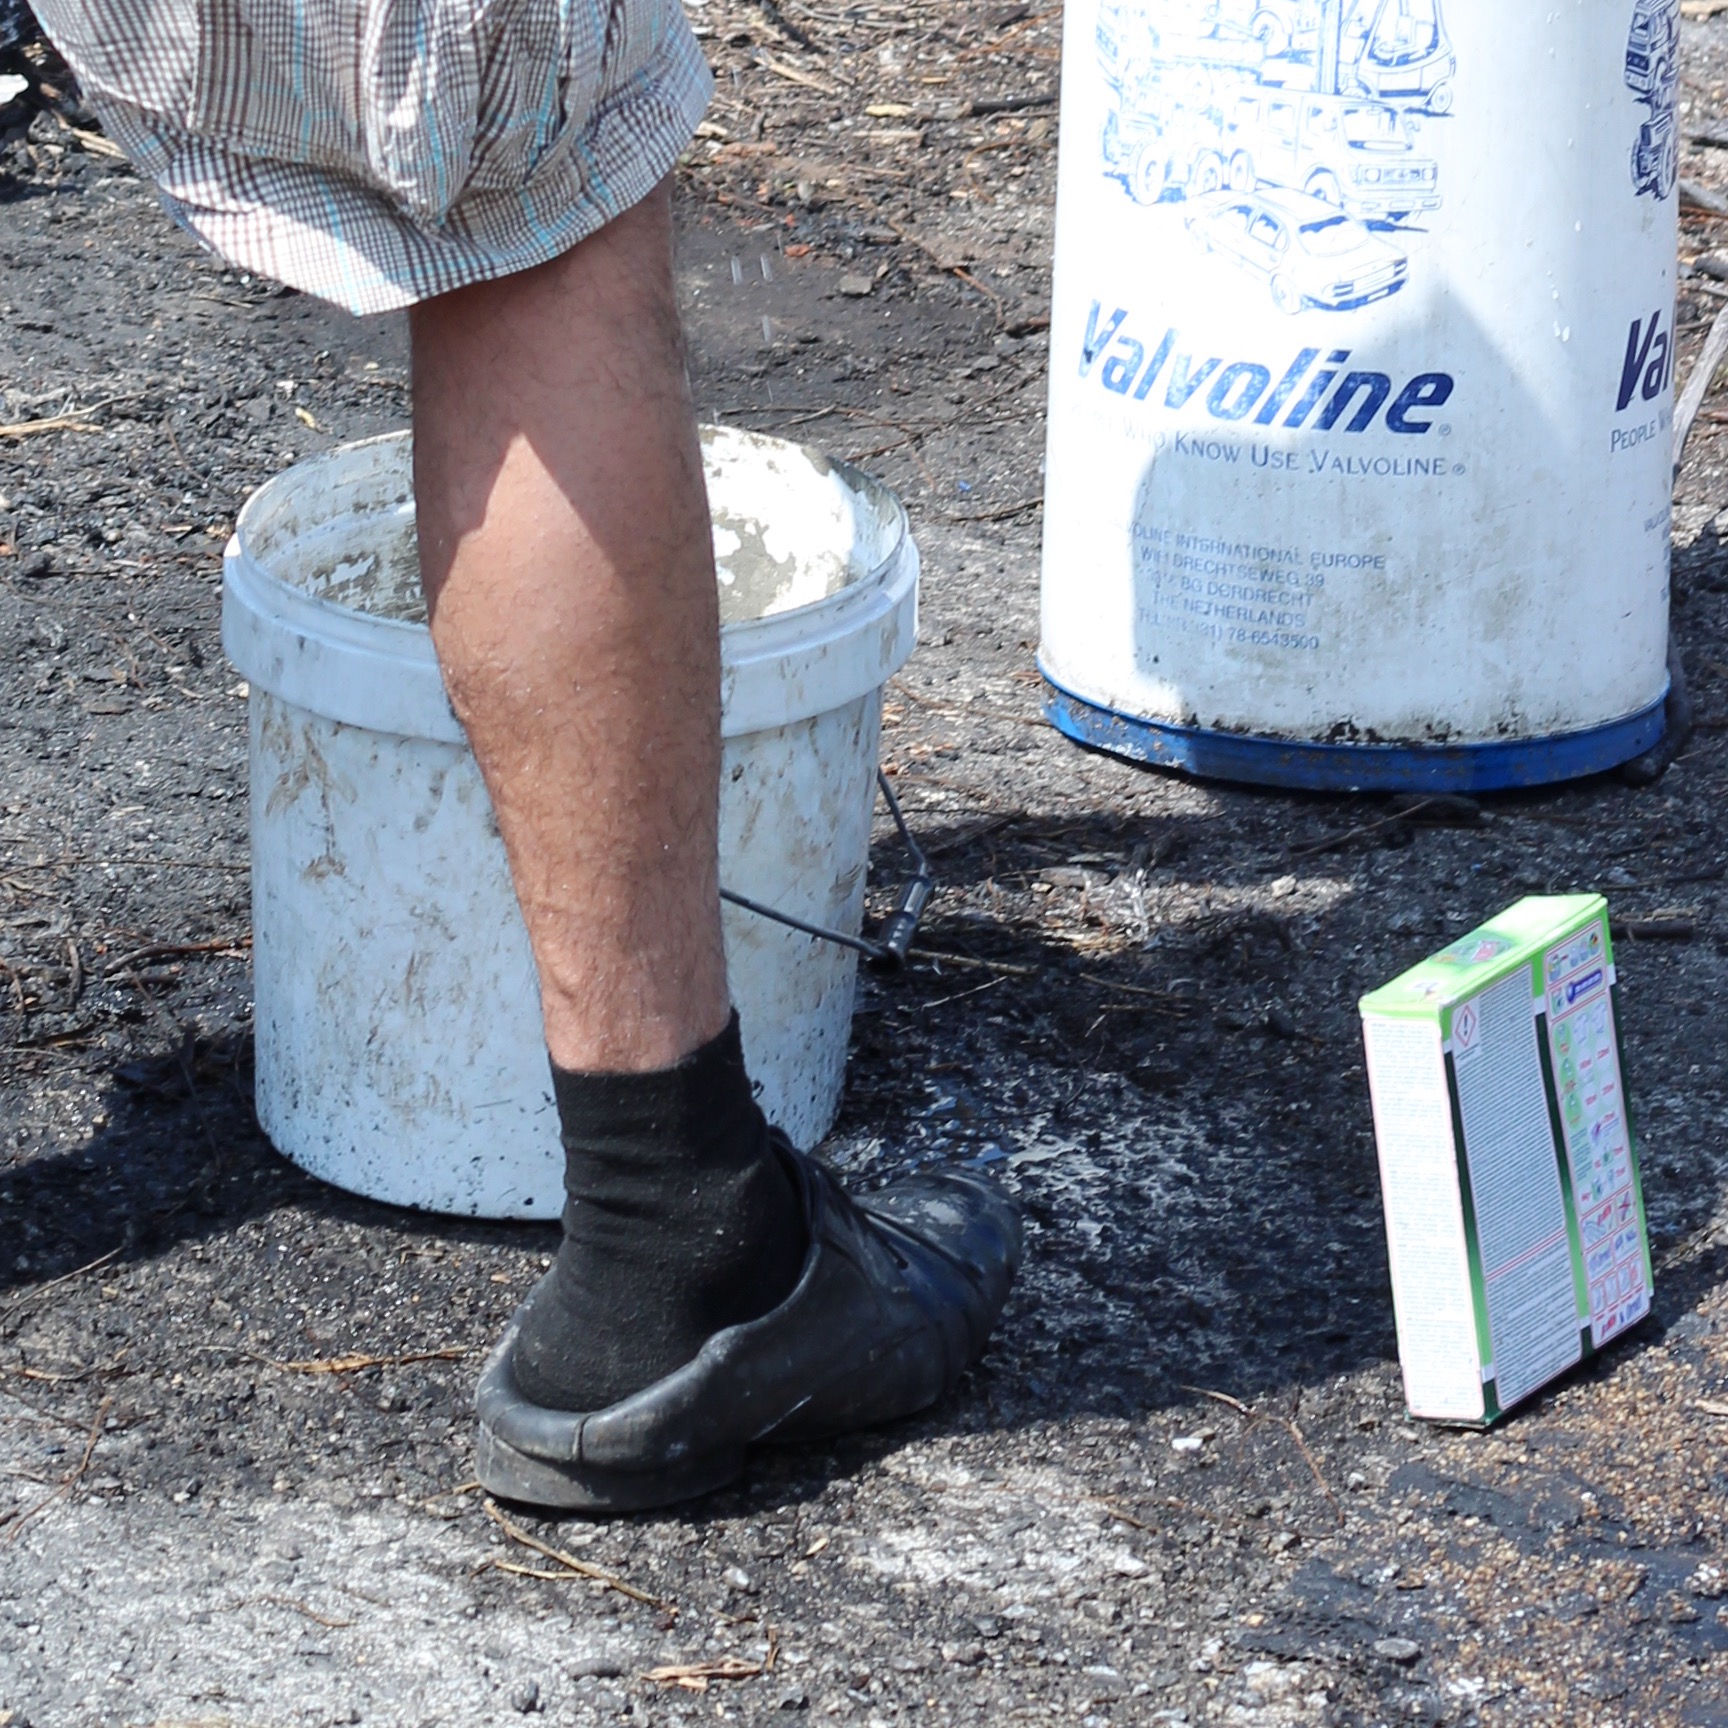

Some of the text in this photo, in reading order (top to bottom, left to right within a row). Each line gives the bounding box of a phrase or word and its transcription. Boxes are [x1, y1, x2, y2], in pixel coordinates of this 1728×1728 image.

[1078, 298, 1454, 435] Valvoline
[1175, 431, 1242, 464] KNOW
[1251, 445, 1300, 472] USE
[1310, 449, 1447, 476] VALVOLINE
[1610, 421, 1656, 453] PEOPLE
[1175, 532, 1303, 566] INTERNATIONAL
[1310, 551, 1387, 570] EUROPE
[1183, 597, 1306, 628] NETHERLANDS
